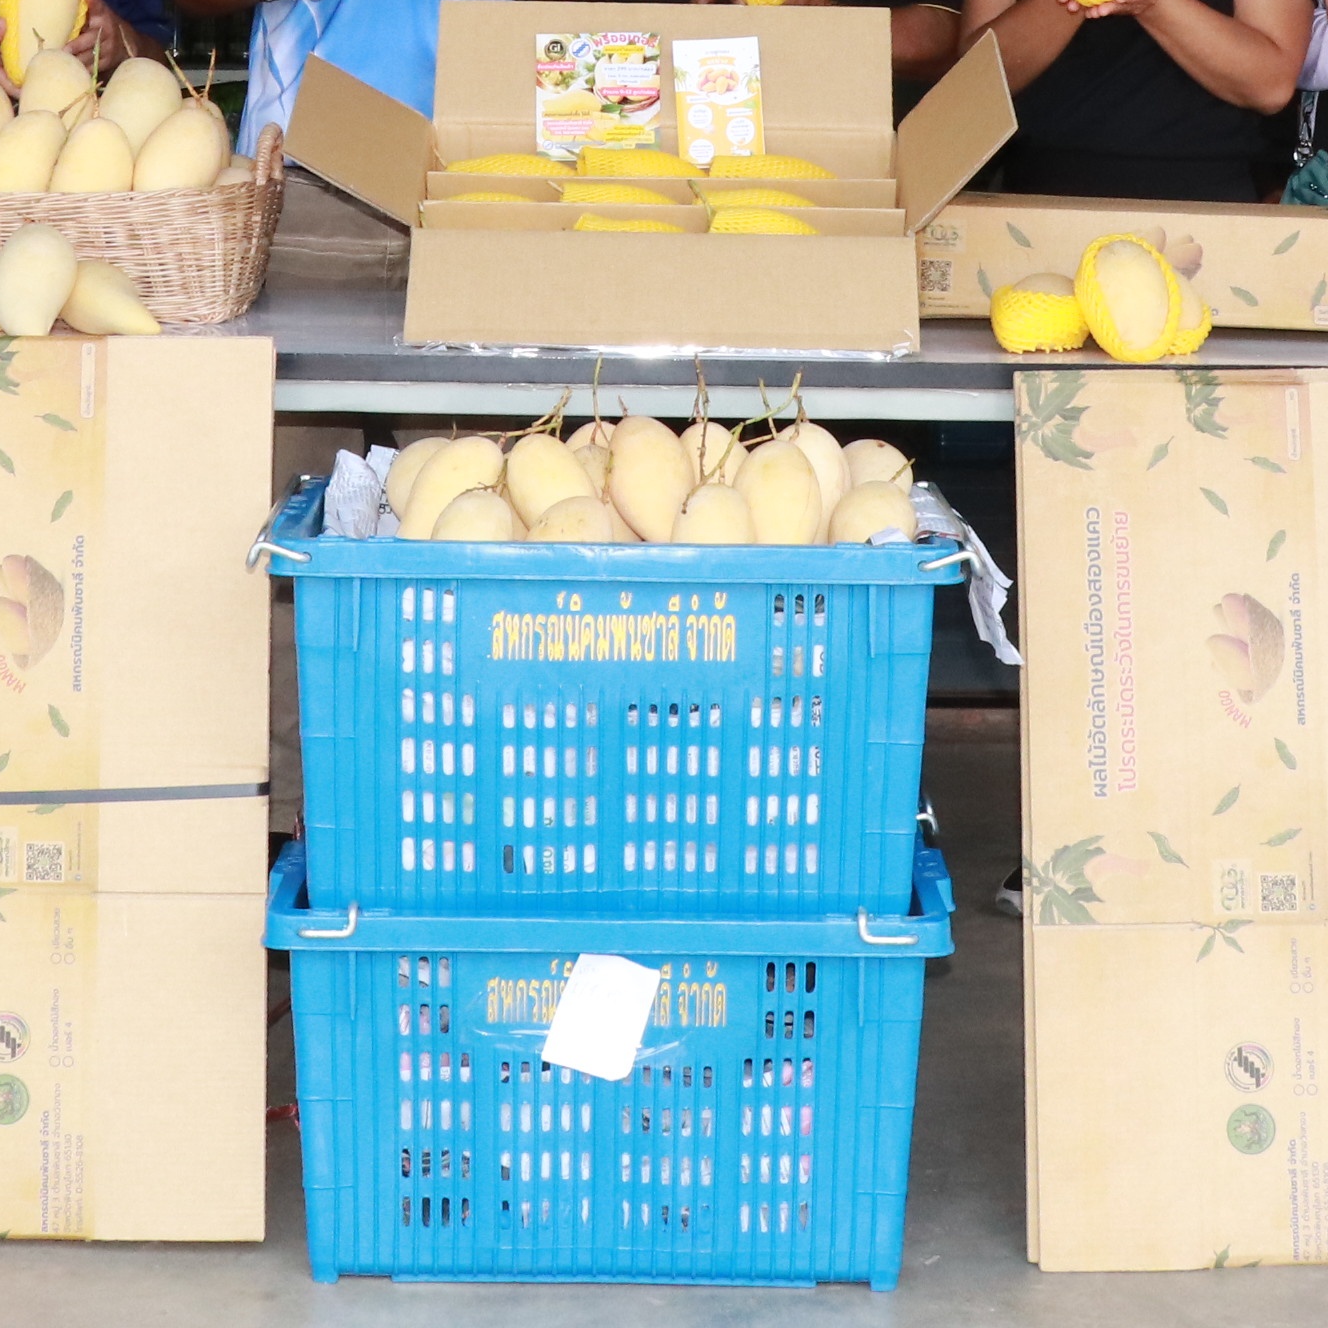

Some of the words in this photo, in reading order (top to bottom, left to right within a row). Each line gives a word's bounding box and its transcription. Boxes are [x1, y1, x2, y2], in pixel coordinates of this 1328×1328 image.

[73, 535, 84, 570] จำกัด
[491, 590, 680, 662] สหกรณ์นิคมพันชาลี
[685, 591, 737, 662] จำกัด
[1083, 506, 1110, 798] ผลไม้อัตลักษณ์เมืองสองแคว
[1111, 510, 1137, 792] โปรดระมัดระวังในการขนย้าย
[1218, 689, 1252, 729] MANGO
[678, 960, 727, 1027] จำกัด
